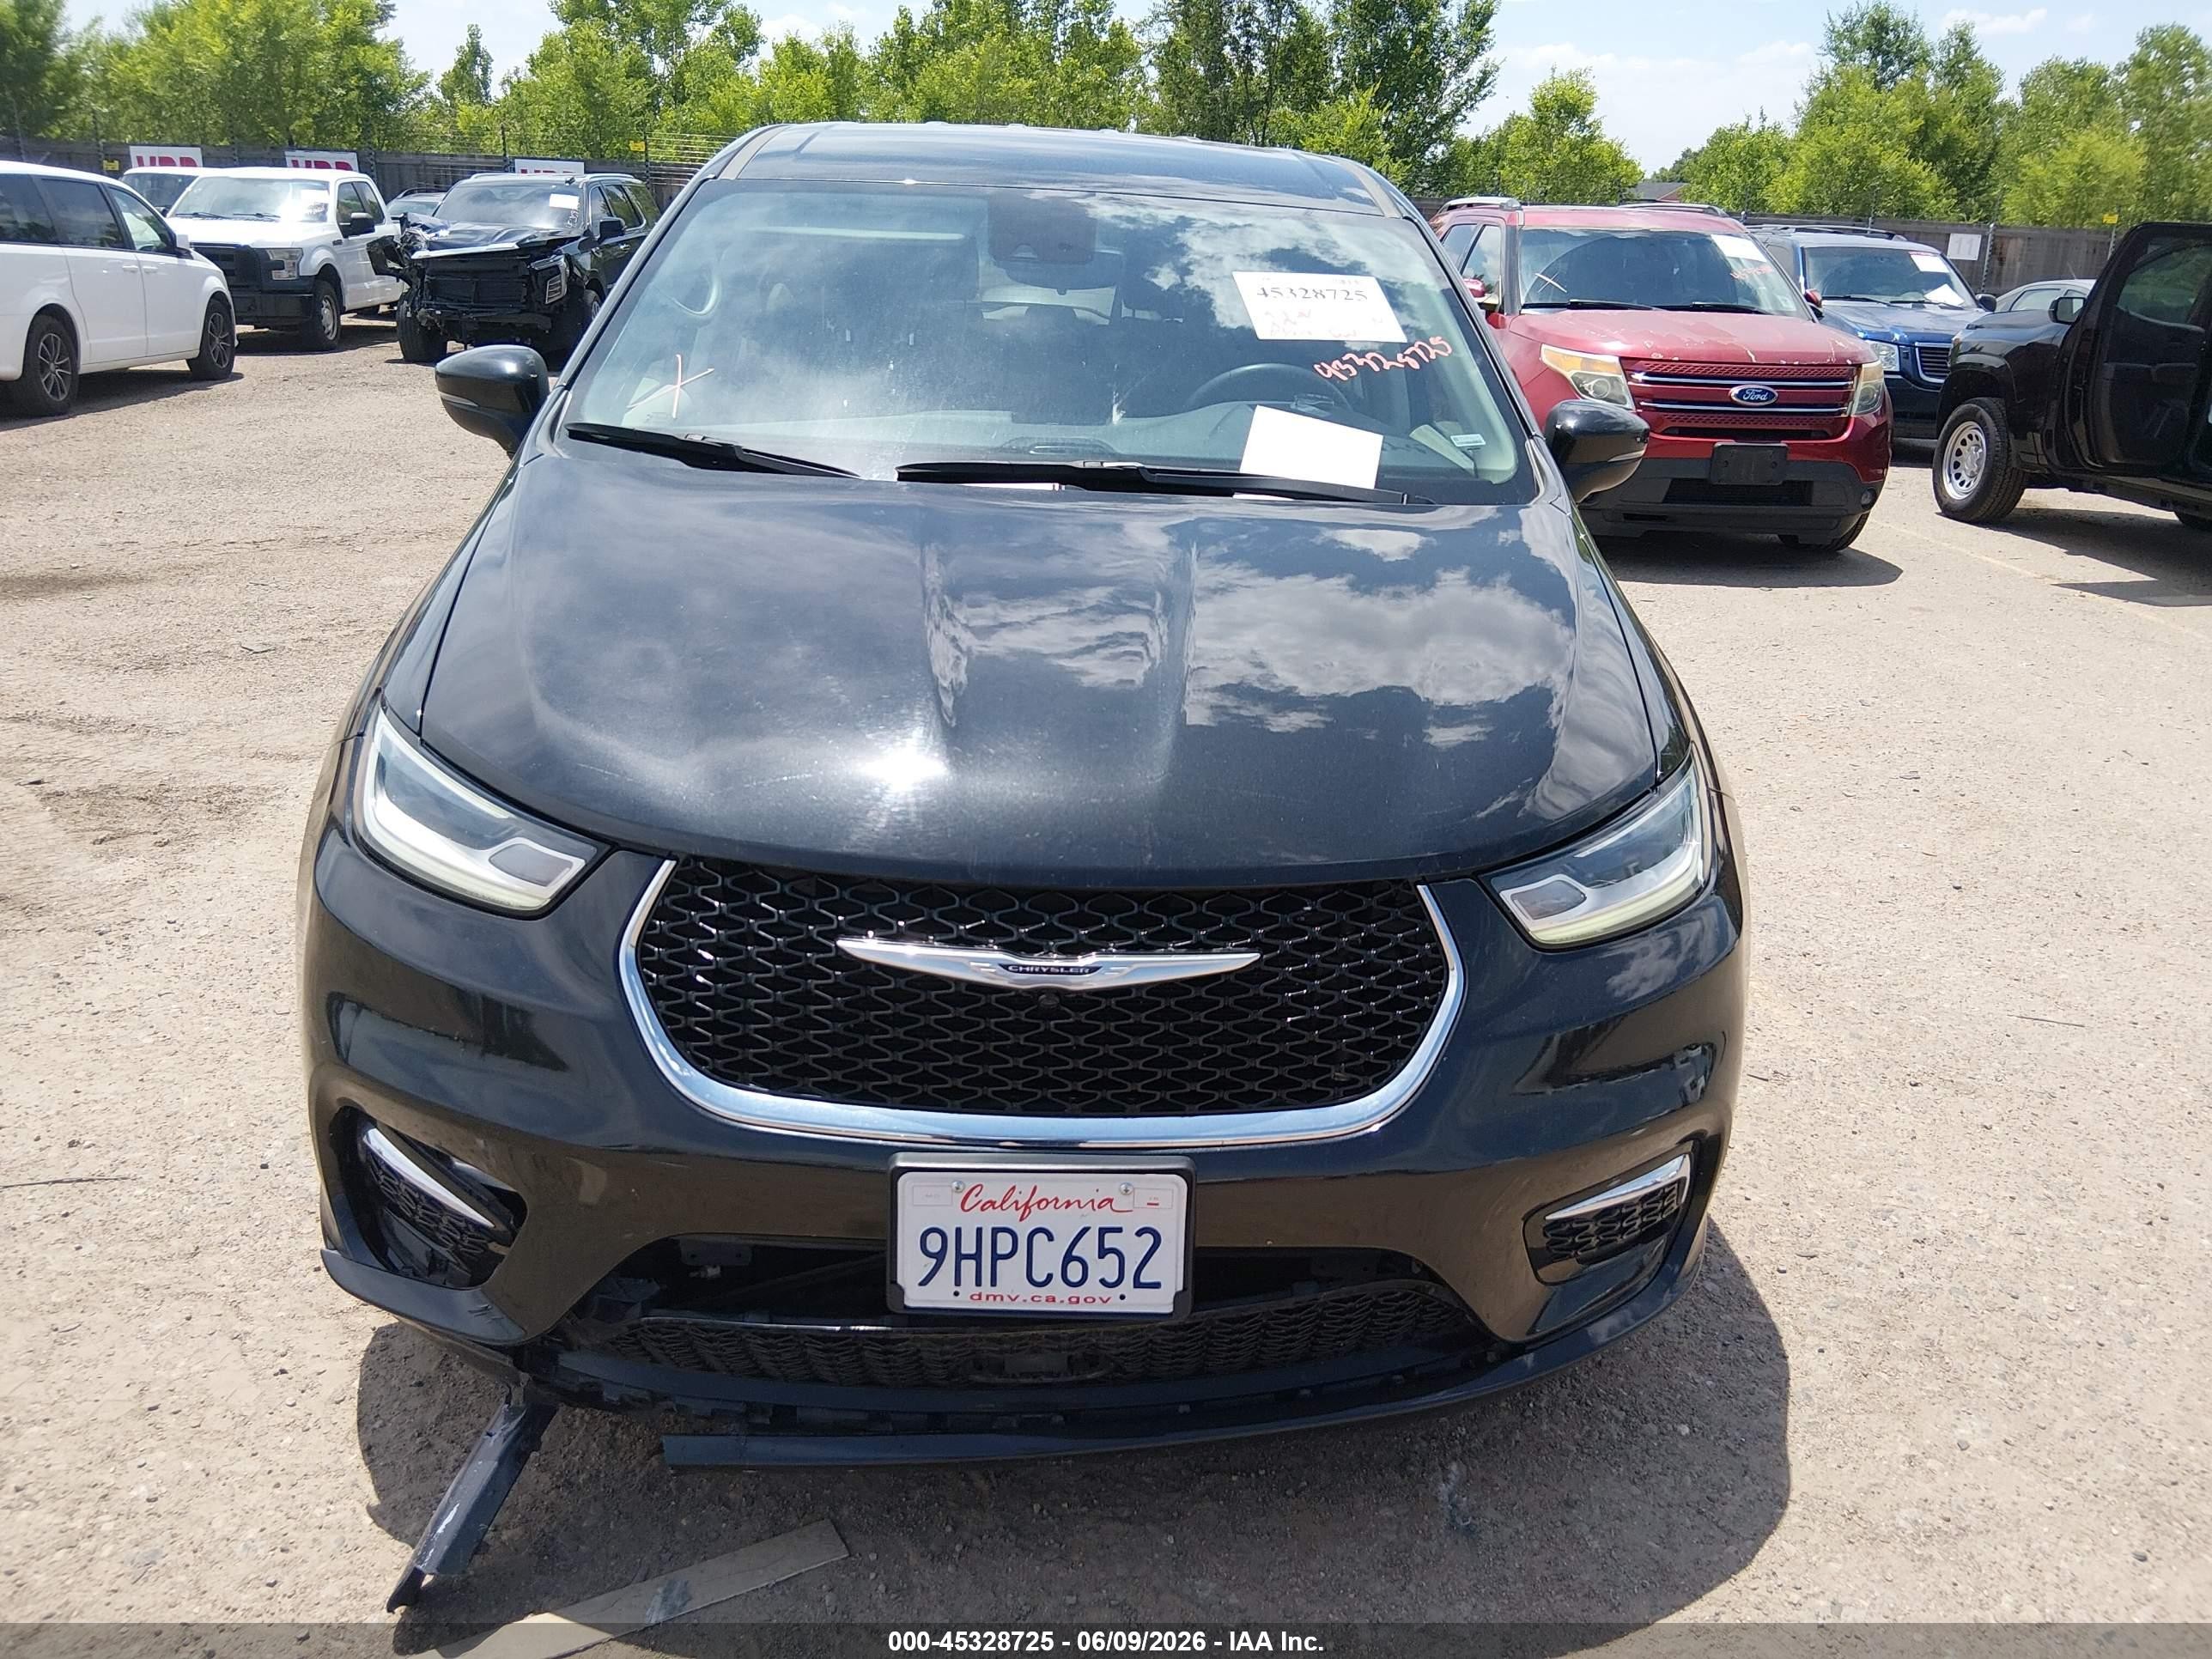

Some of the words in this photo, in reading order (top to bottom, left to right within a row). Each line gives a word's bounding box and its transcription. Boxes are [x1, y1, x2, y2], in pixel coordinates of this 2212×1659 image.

[1256, 286, 1368, 301] 45328725
[1742, 388, 1769, 401] Ford
[1007, 964, 1090, 974] CHRYSLER
[960, 1183, 1133, 1222] California
[918, 1225, 1163, 1290] 9HPC652
[969, 1291, 1112, 1305] dmv.ca.gov
